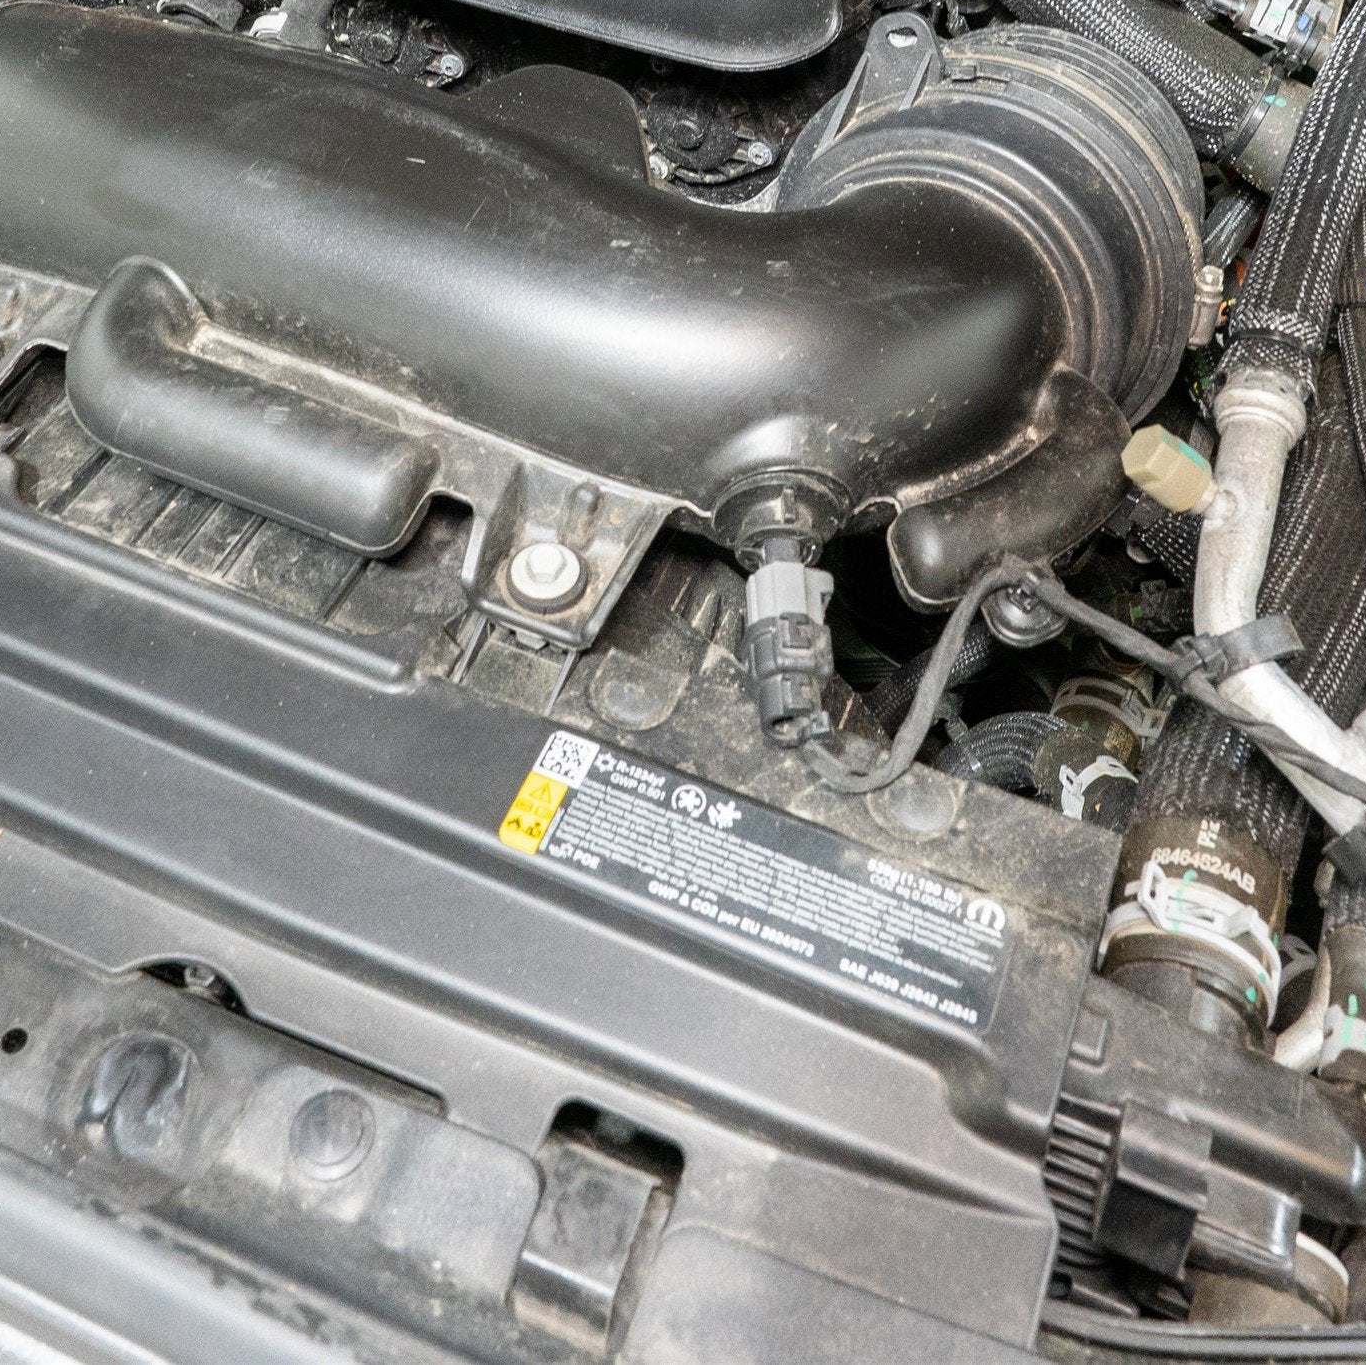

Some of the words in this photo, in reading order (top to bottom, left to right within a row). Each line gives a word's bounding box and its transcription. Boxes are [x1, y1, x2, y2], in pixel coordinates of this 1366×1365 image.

[610, 772, 638, 791] GWP
[616, 760, 666, 787] R-1234yf
[648, 880, 680, 902] GWP
[690, 897, 719, 919] CO2
[741, 917, 762, 936] EU
[839, 957, 868, 980] SAE
